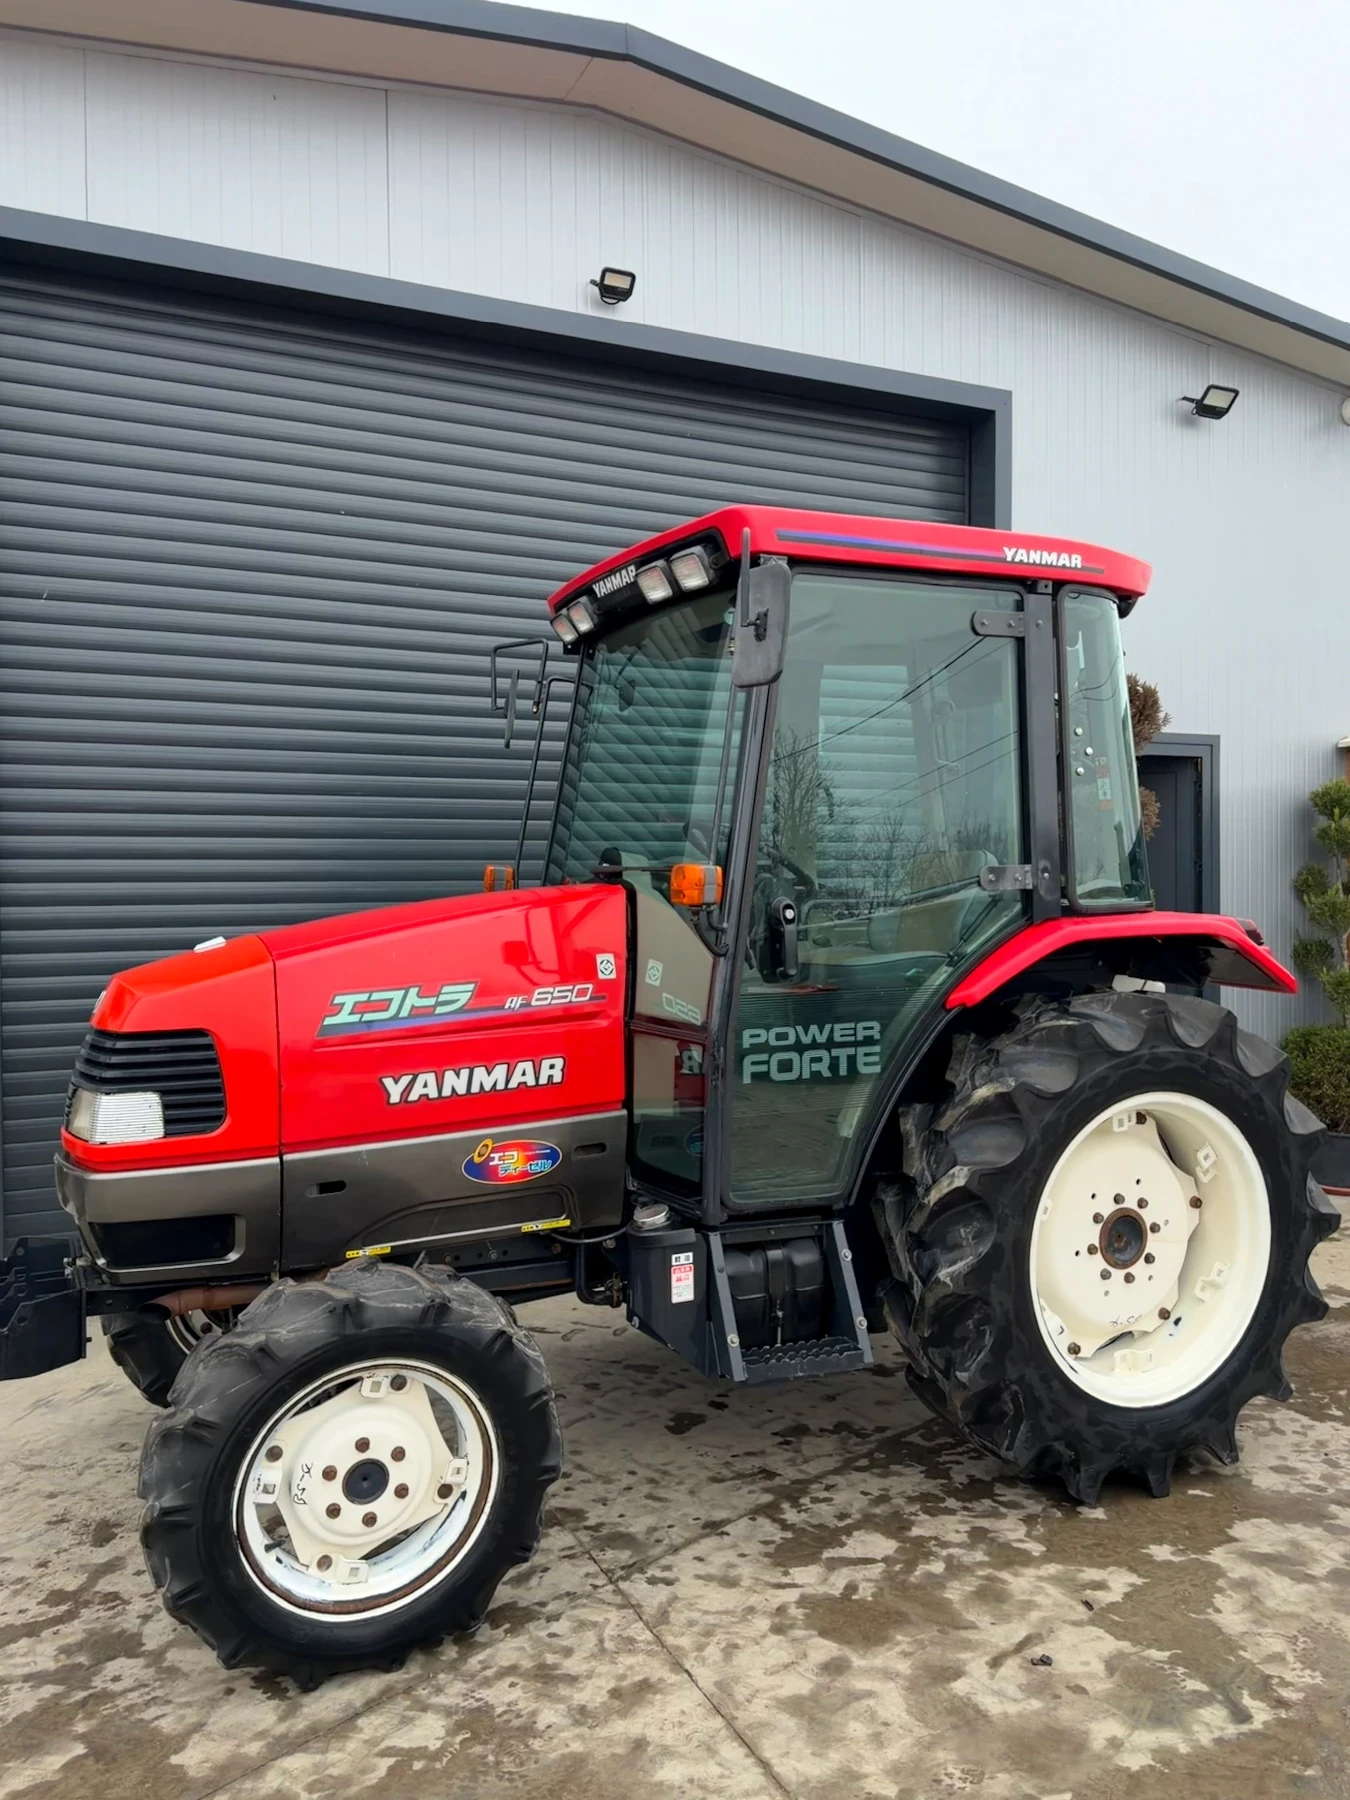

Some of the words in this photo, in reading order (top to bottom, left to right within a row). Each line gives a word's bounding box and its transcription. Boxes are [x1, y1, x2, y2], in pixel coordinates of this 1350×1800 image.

[1003, 546, 1082, 568] YANMAR
[322, 982, 476, 1026] エコトラ
[530, 983, 594, 1006] 650
[742, 1021, 881, 1048] POWER
[742, 1045, 881, 1084] FORTE
[381, 1056, 566, 1105] YANMAR
[489, 1151, 518, 1166] エコ
